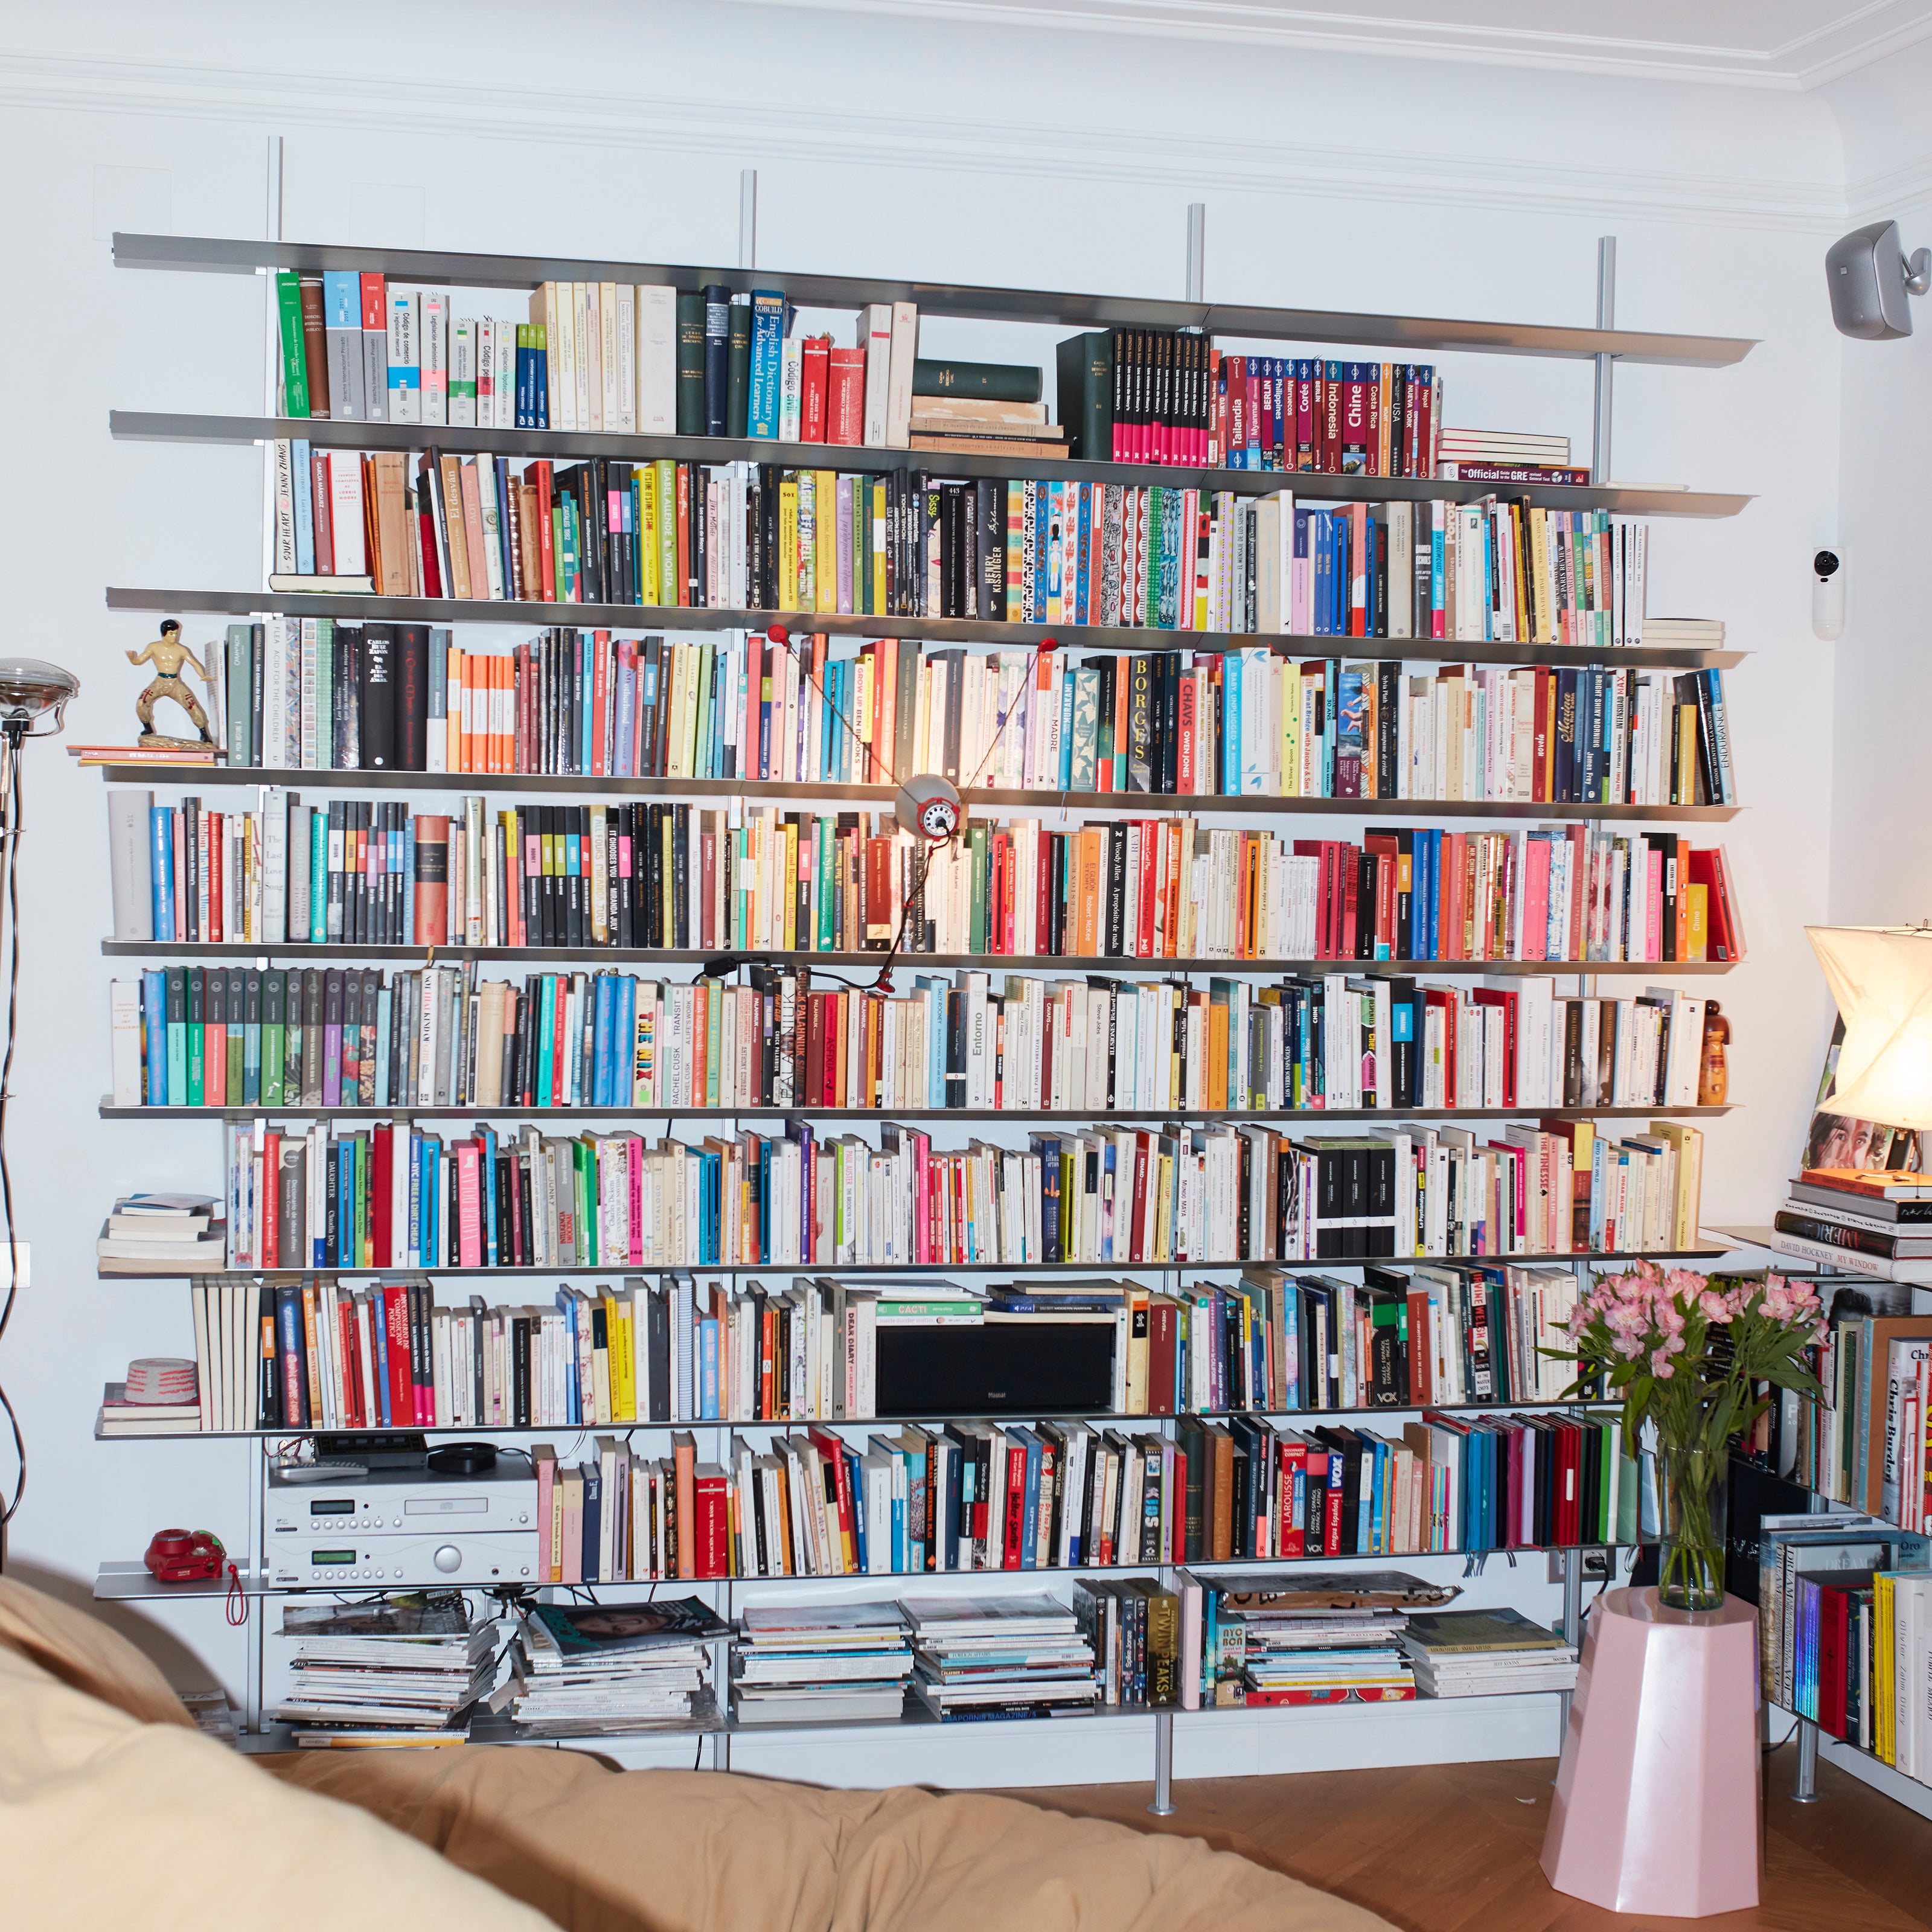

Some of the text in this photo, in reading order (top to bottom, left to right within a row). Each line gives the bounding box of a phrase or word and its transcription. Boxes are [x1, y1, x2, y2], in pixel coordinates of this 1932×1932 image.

[482, 345, 490, 367] Código
[753, 315, 767, 420] for Advanced Learners
[763, 315, 780, 423] English Dictionary
[786, 361, 798, 411] Código civil
[1299, 384, 1309, 412] Corée
[1349, 385, 1361, 427] Chine
[1232, 399, 1242, 446] Tailandia
[1328, 383, 1338, 438] Indonesia
[278, 444, 289, 497] JENNY ZHANG
[1468, 468, 1499, 479] Official
[1511, 471, 1528, 481] GRE
[447, 471, 459, 518] El desván
[927, 494, 940, 517] Sissy
[280, 512, 291, 560] SOUR HEART
[664, 499, 673, 536] ALLENDE
[799, 476, 812, 561] MAGGIE O'FARRELL
[1445, 504, 1456, 544] Porot
[993, 547, 1002, 592] KISSINGER
[1064, 685, 1072, 722] MURAKAMI
[1183, 685, 1193, 726] CHAVS
[1594, 675, 1602, 697] BRIGHT
[1135, 661, 1147, 759] BORGES
[1558, 693, 1570, 743] Marina
[1593, 699, 1601, 717] SHINY
[1616, 696, 1624, 729] INTENSIDAD
[1535, 734, 1545, 756] novela
[1715, 706, 1729, 768] ENDURANCE
[1584, 772, 1593, 784] Frey
[609, 837, 617, 865] CHOOSES
[824, 857, 833, 879] Sykes
[1113, 842, 1122, 863] Woody
[610, 915, 618, 930] JULY
[1111, 894, 1121, 923] propósito
[637, 1012, 653, 1081] THE NIX
[973, 1012, 982, 1055] Entorno
[825, 1037, 836, 1072] ASFIXIA
[1540, 1137, 1548, 1188] THE FINESSE
[462, 1172, 478, 1240] XAVIER DOLAN
[1781, 1241, 1879, 1271] DAVID HOCKNEY MY WINDOW
[898, 1305, 927, 1313] CACTI
[1473, 1273, 1485, 1338] IRVINE WELSH
[1884, 1379, 1899, 1484] Chris Burden
[1332, 1456, 1342, 1488] VOX
[1283, 1474, 1293, 1523] LAROUSSE
[1331, 1500, 1339, 1526] Española
[1786, 1550, 1794, 1599] DREAM
[1156, 1608, 1170, 1692] TWIN PEAKS
